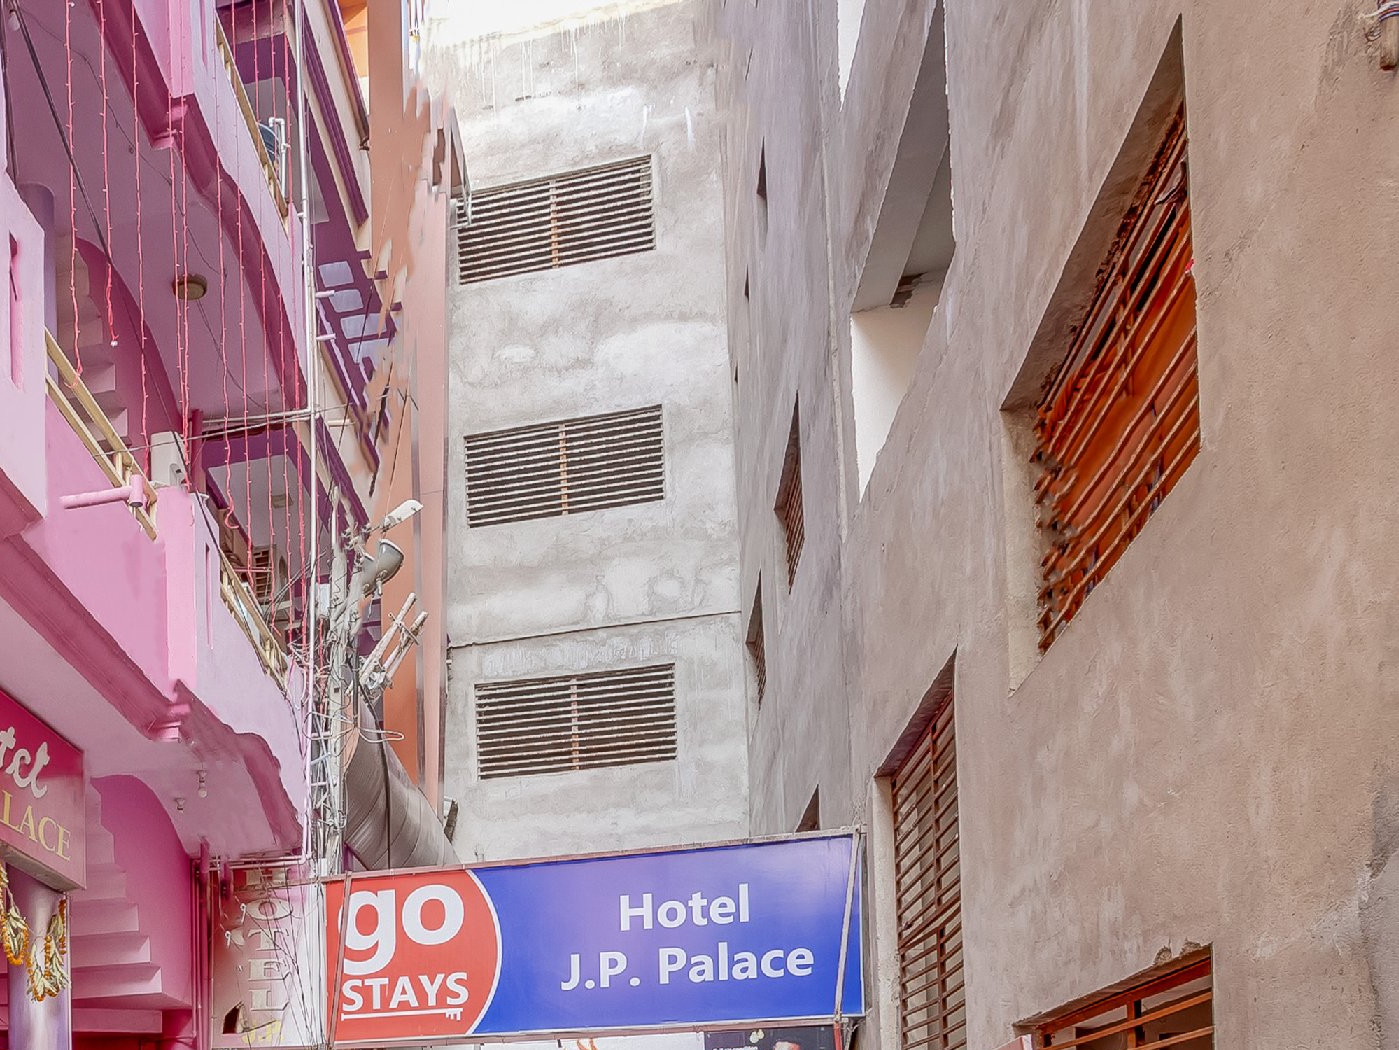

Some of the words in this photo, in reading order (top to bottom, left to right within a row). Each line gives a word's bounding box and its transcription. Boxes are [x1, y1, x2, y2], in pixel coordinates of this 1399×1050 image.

[338, 885, 465, 976] go
[619, 883, 750, 931] Hotel
[560, 950, 641, 991] J.P.
[658, 941, 815, 985] Palace
[342, 972, 469, 1012] STAYS
